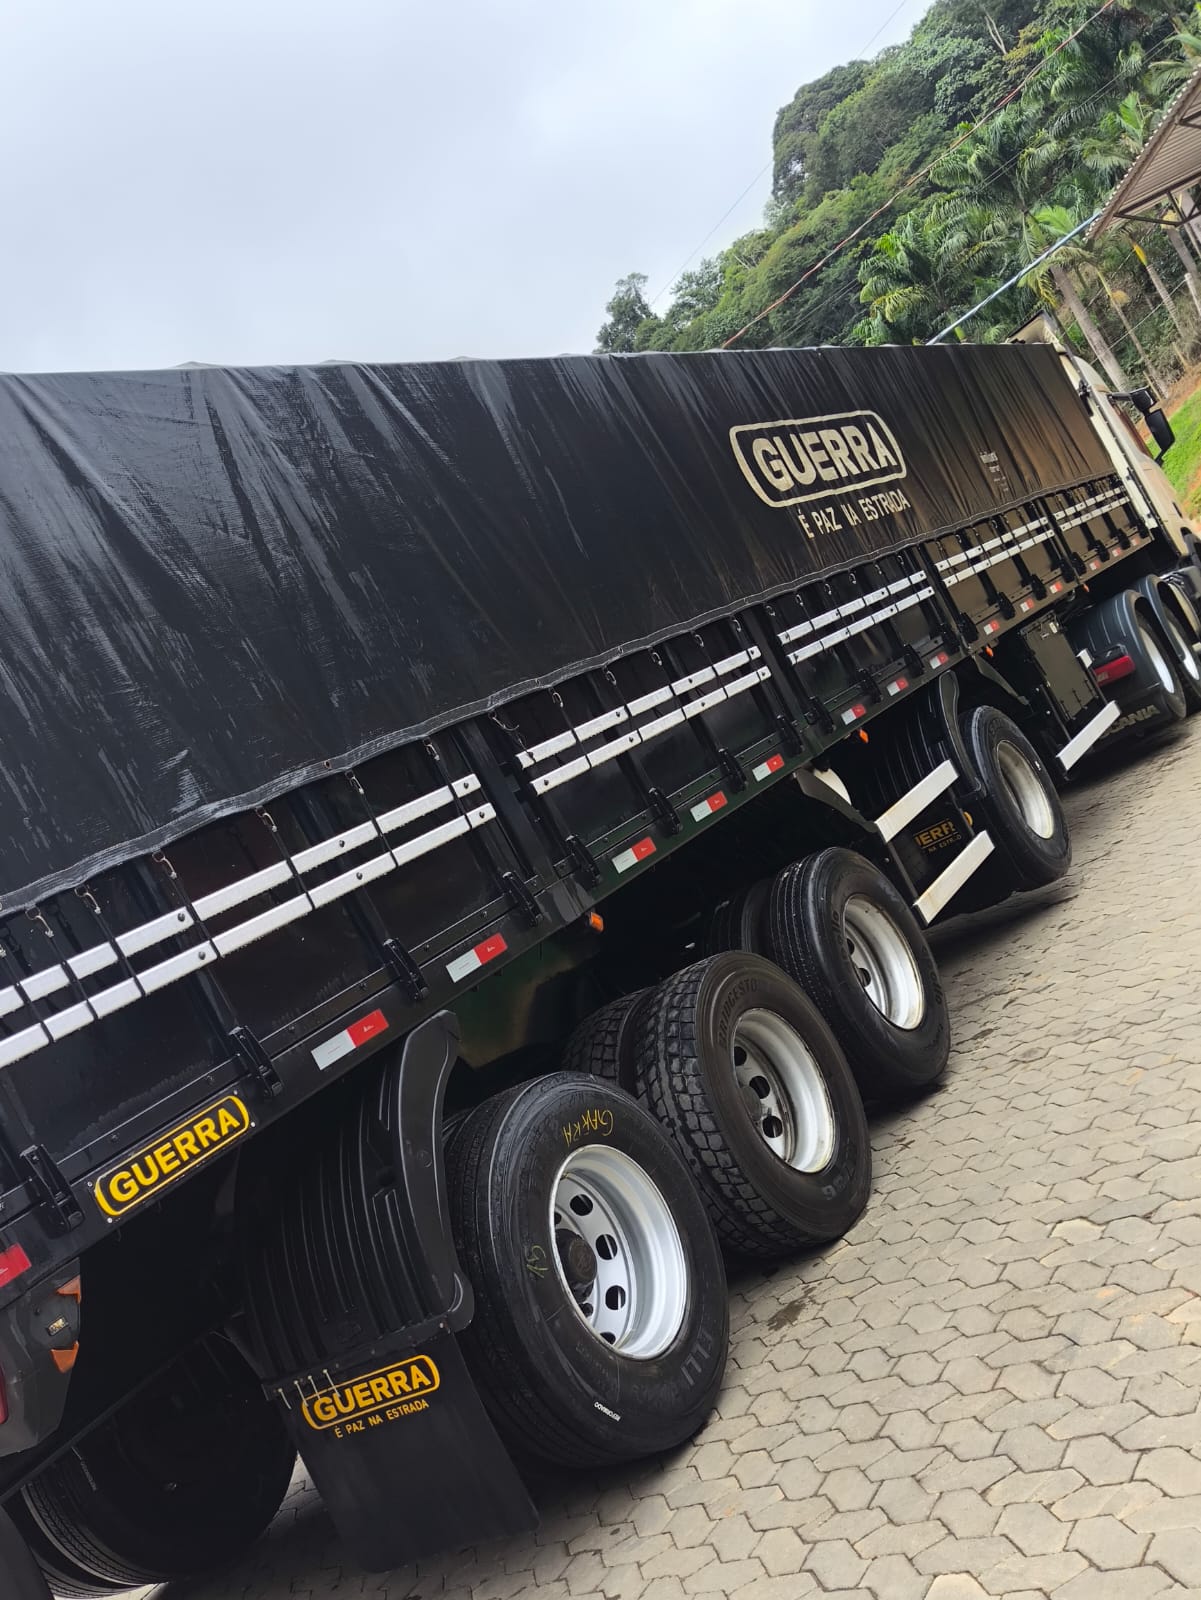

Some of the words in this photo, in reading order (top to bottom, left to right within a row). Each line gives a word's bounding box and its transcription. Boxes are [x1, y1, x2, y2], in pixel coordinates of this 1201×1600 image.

[752, 423, 898, 492] GUERRA
[797, 507, 814, 538] É
[814, 510, 842, 536] PAZ
[861, 488, 911, 521] ESTRADA
[108, 1107, 240, 1203] GUERRA
[313, 1364, 432, 1422] GUERRA
[334, 1425, 344, 1439] É
[345, 1420, 366, 1436] PAZ
[368, 1415, 384, 1427] NA
[386, 1398, 430, 1421] ESTRADA
